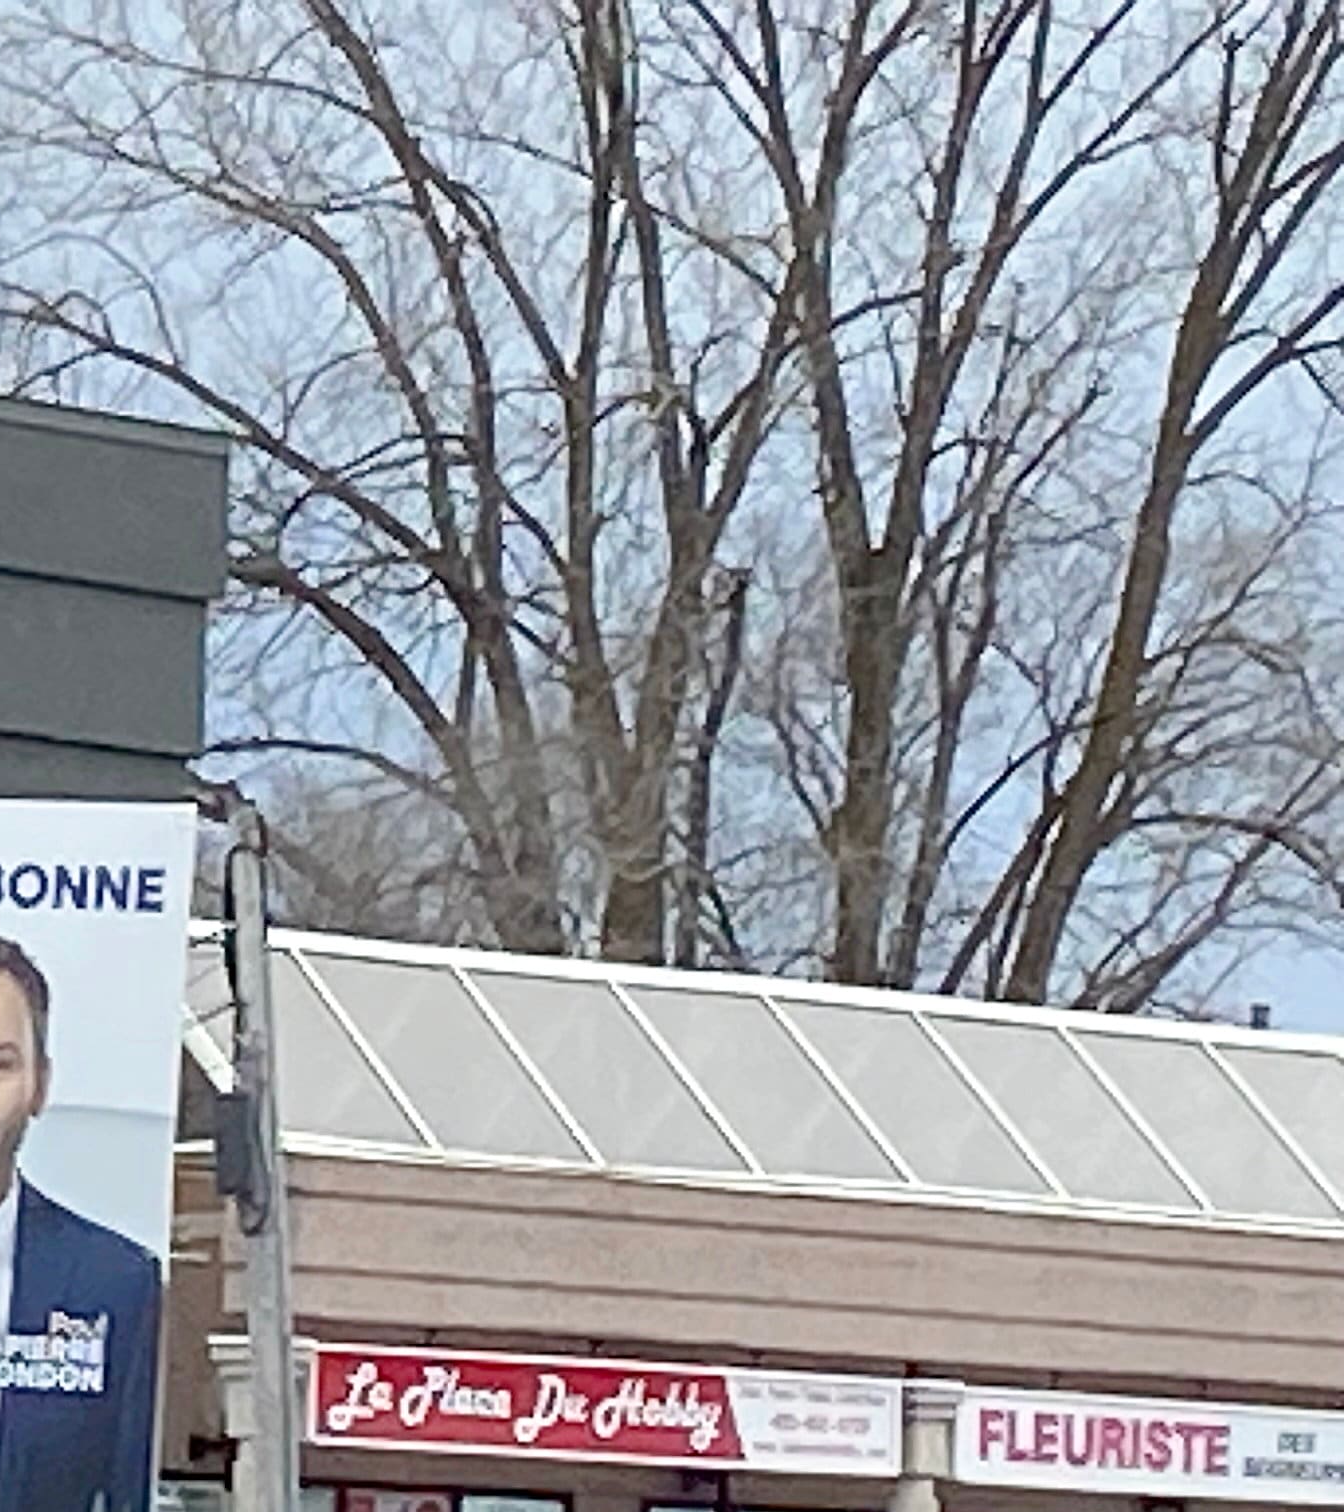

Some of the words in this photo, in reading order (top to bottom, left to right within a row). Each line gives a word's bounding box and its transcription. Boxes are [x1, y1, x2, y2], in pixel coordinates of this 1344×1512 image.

[513, 1373, 590, 1443] Du
[592, 1378, 723, 1453] Hobby
[978, 1409, 1231, 1476] FLEURISTE
